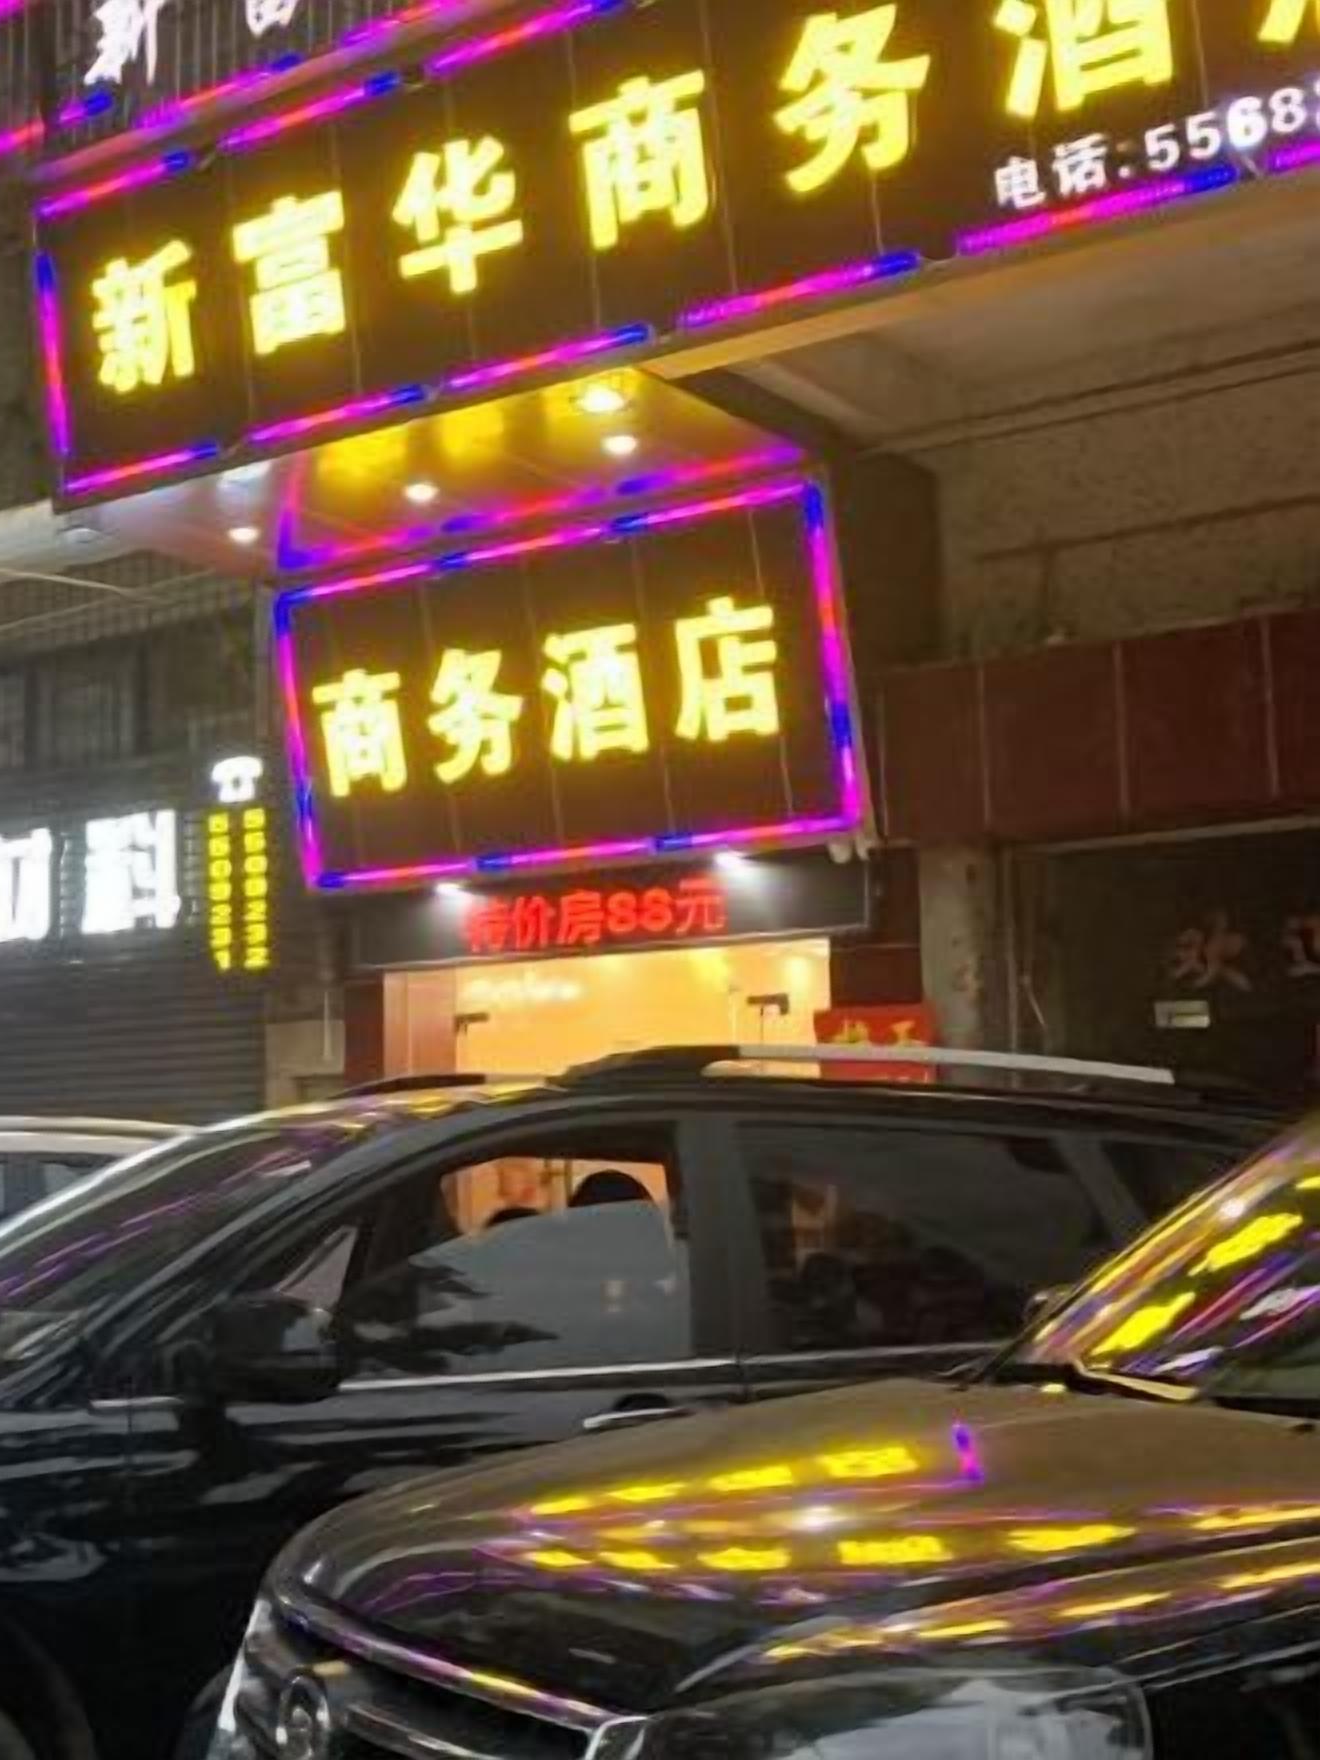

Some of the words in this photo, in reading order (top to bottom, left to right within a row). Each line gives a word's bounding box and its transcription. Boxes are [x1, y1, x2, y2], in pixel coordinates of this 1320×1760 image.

[312, 597, 778, 797] 商务酒店
[463, 872, 727, 953] 特价房88元
